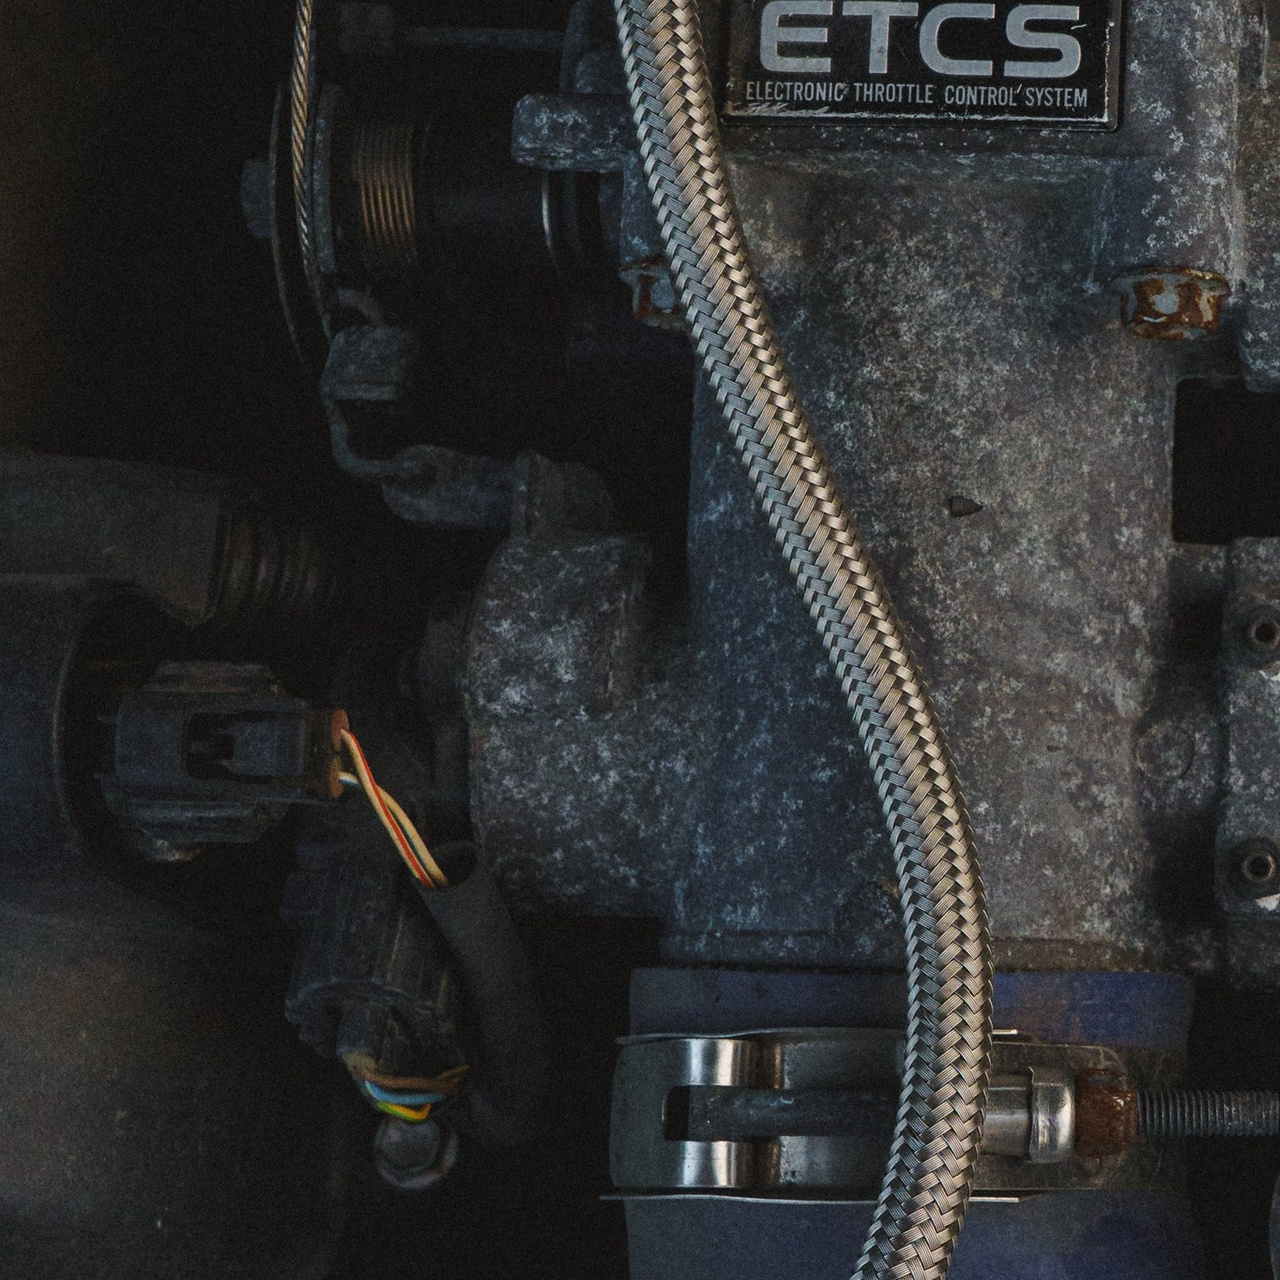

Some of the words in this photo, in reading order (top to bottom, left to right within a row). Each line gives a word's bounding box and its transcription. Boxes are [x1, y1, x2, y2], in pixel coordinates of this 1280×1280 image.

[759, 0, 1082, 79] ETCS
[745, 81, 845, 103] ELECTRONIC
[854, 83, 935, 105] THROTTLE
[945, 85, 1016, 107] CONTROL
[1025, 87, 1088, 108] SYSTEM
